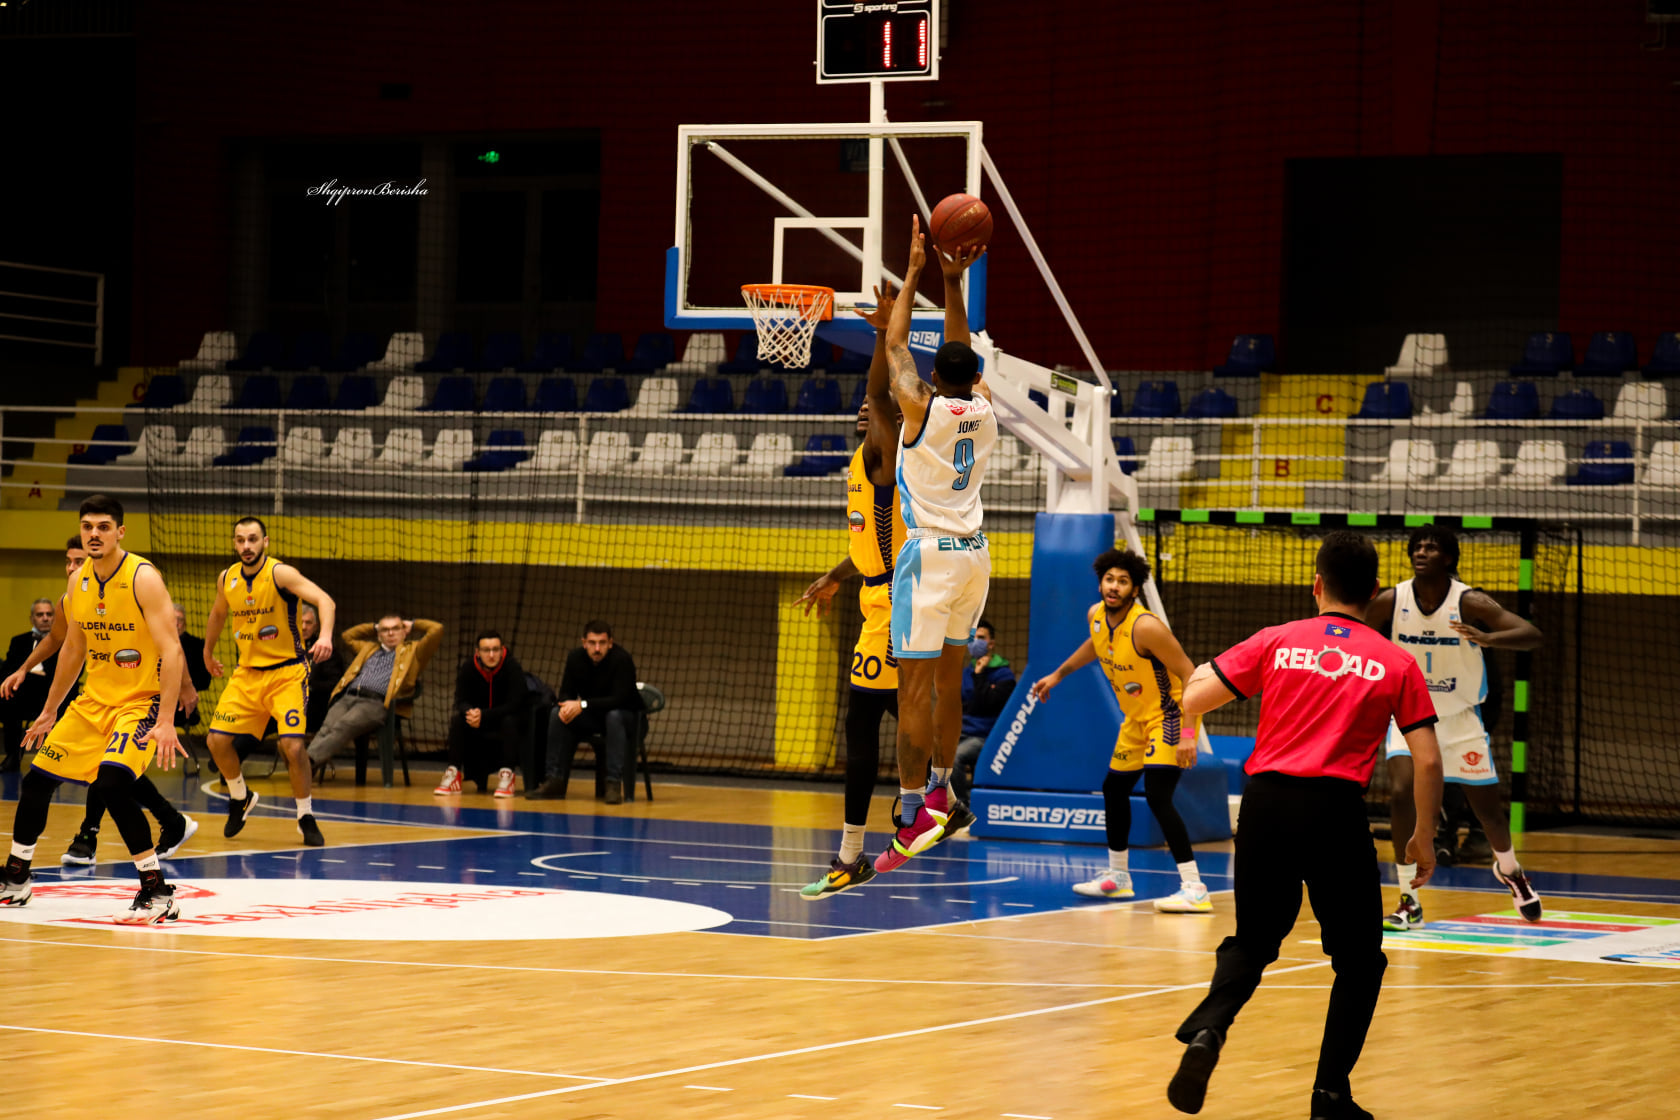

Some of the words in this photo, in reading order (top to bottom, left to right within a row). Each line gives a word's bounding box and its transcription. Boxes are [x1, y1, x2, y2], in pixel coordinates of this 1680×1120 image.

[1315, 394, 1334, 414] C
[952, 438, 976, 491] 9
[1275, 458, 1290, 478] B
[851, 651, 882, 680] 20
[1274, 644, 1386, 681] RELOAD
[1425, 651, 1433, 673] 1
[285, 709, 301, 728] 6
[105, 731, 130, 755] 21
